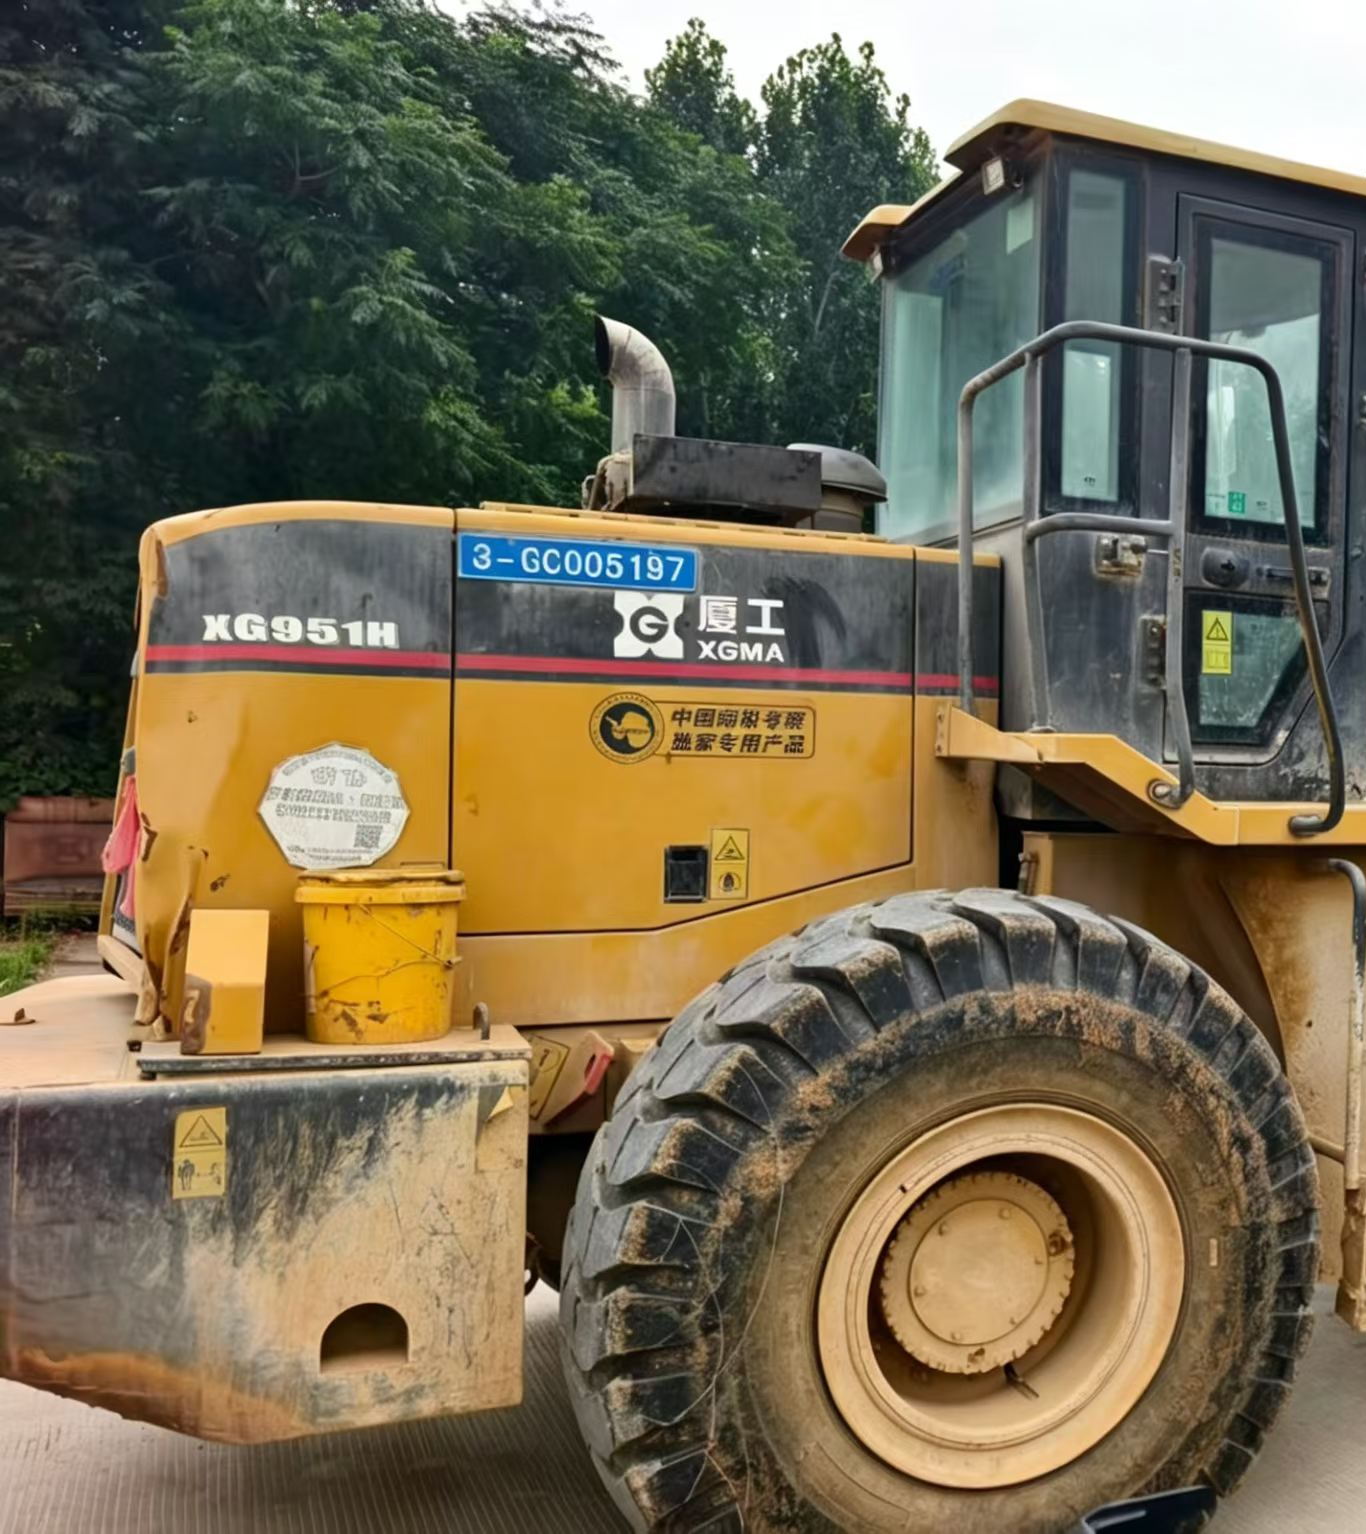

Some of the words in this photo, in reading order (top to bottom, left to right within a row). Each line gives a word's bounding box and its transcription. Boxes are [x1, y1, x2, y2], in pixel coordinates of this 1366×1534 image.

[472, 543, 685, 583] 3-GC005197
[202, 613, 400, 649] XG951H
[697, 595, 786, 636] 厦工
[697, 640, 785, 663] XGMA
